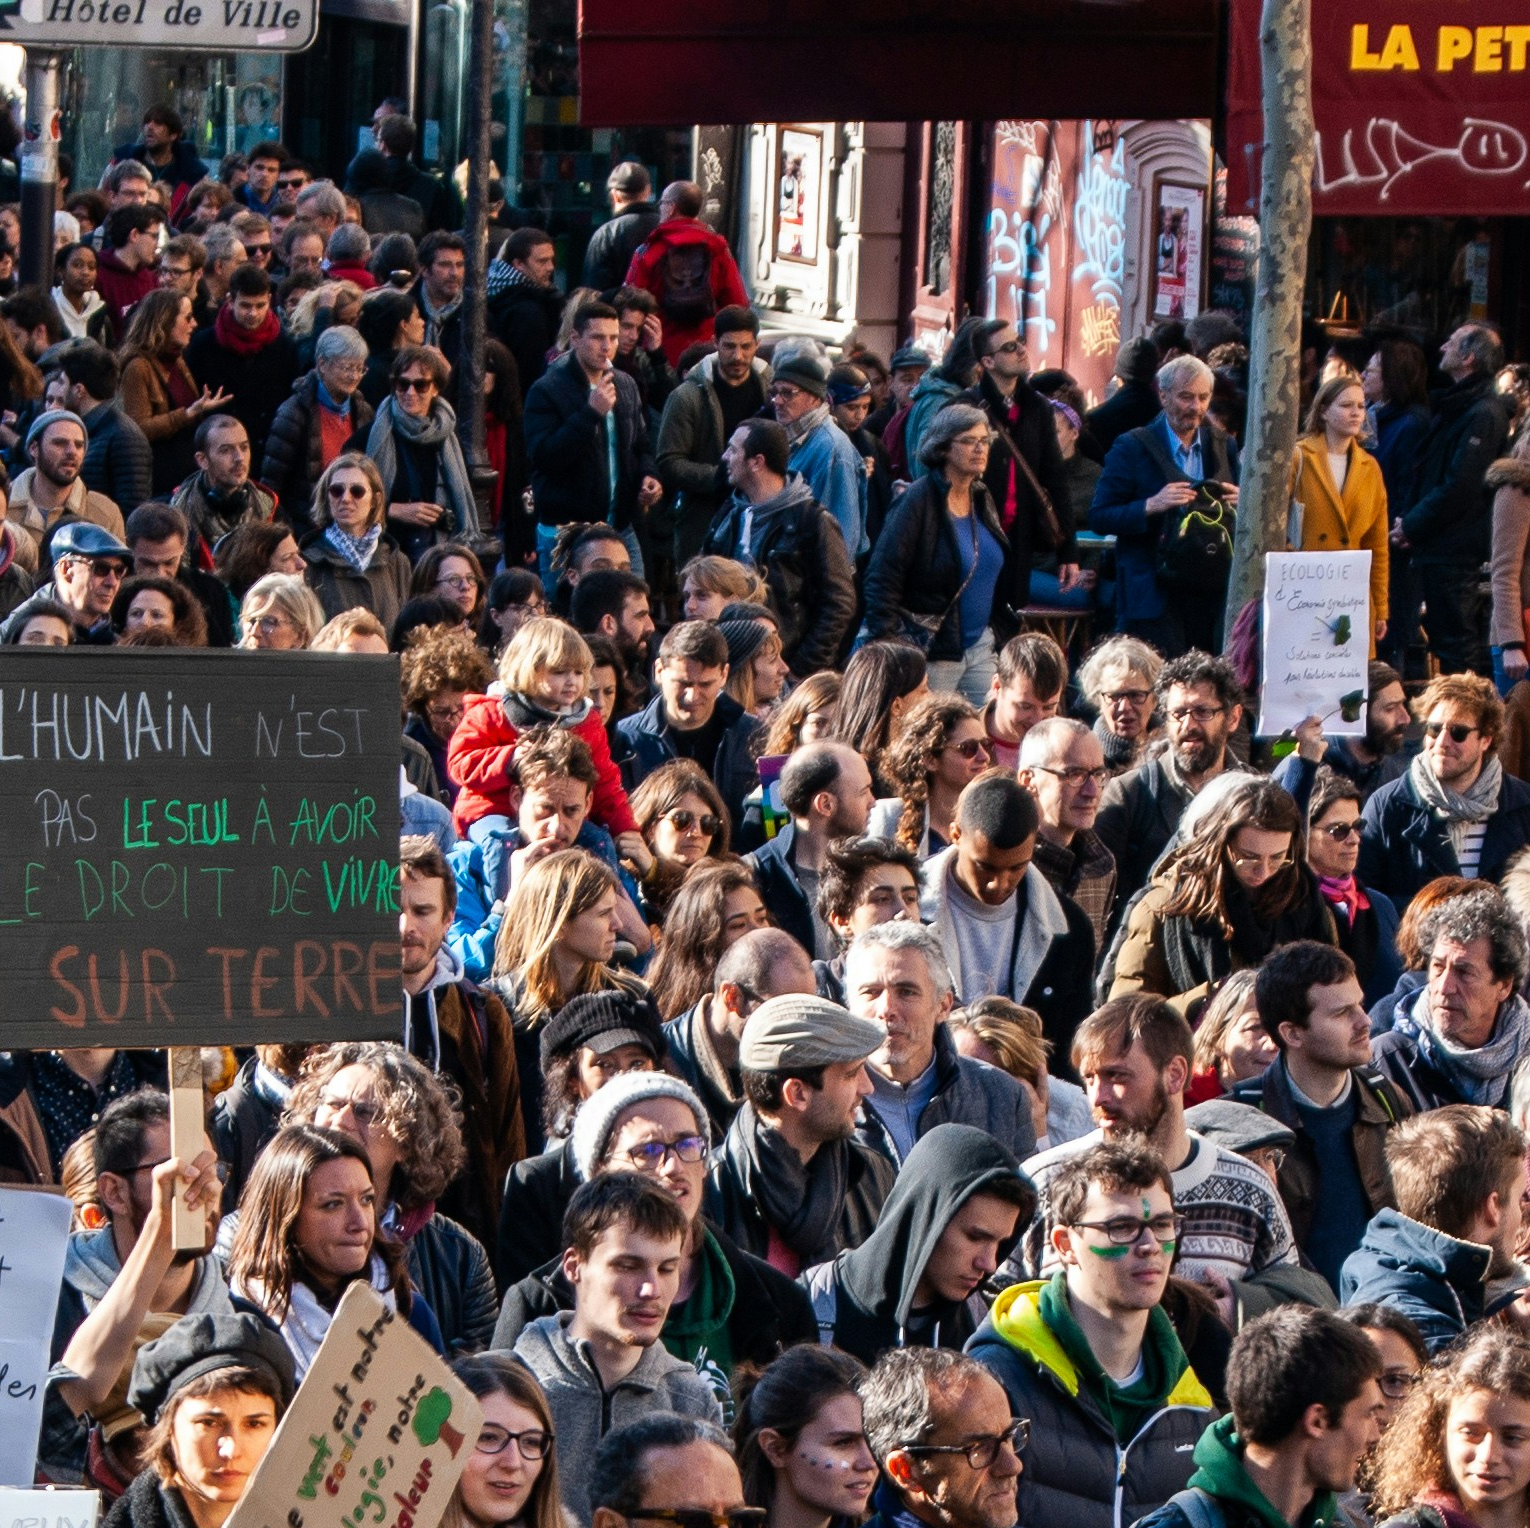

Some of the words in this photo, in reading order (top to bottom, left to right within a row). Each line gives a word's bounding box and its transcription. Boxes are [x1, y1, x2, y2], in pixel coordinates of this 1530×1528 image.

[163, 0, 202, 27] de
[219, 1, 301, 30] Ville
[1350, 24, 1419, 71] LA
[254, 693, 371, 759] N'EST
[33, 788, 99, 848] PAS
[251, 783, 277, 847] À
[74, 858, 236, 922] DROIT
[268, 864, 315, 917] DE
[46, 944, 180, 1029] SUR
[205, 938, 405, 1021] TERRE
[295, 1431, 332, 1501] vert
[331, 1381, 354, 1433] est
[349, 1302, 395, 1385] notre
[387, 1372, 426, 1445] notre
